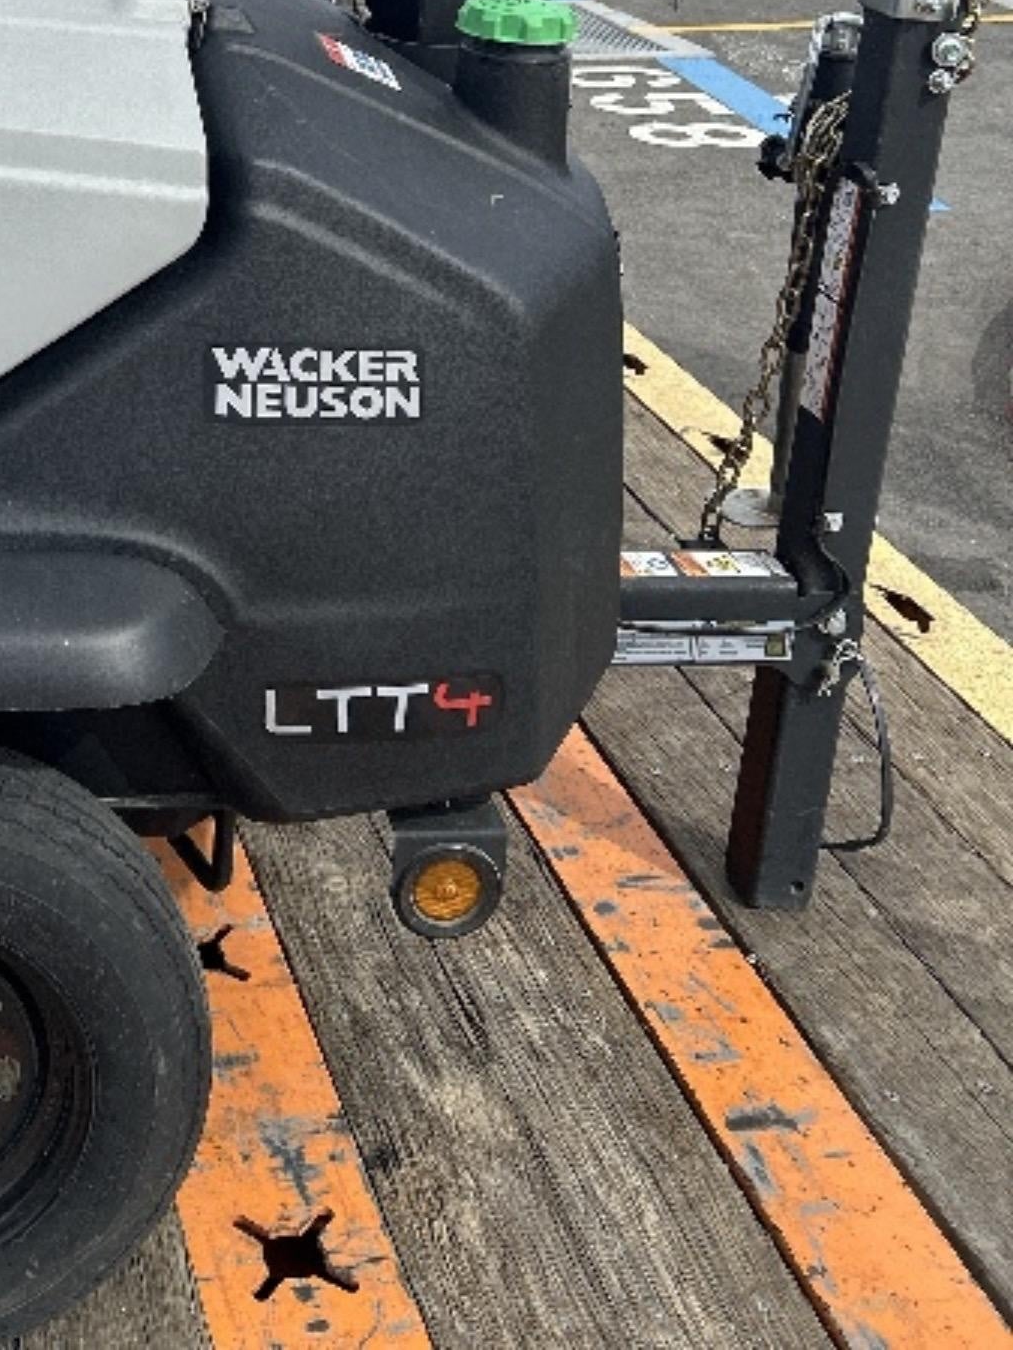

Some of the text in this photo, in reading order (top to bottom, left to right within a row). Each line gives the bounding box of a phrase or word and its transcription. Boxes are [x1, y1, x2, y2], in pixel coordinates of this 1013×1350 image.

[211, 347, 420, 382] WACKER
[214, 383, 420, 419] NEUSON
[265, 683, 492, 735] LTT4
